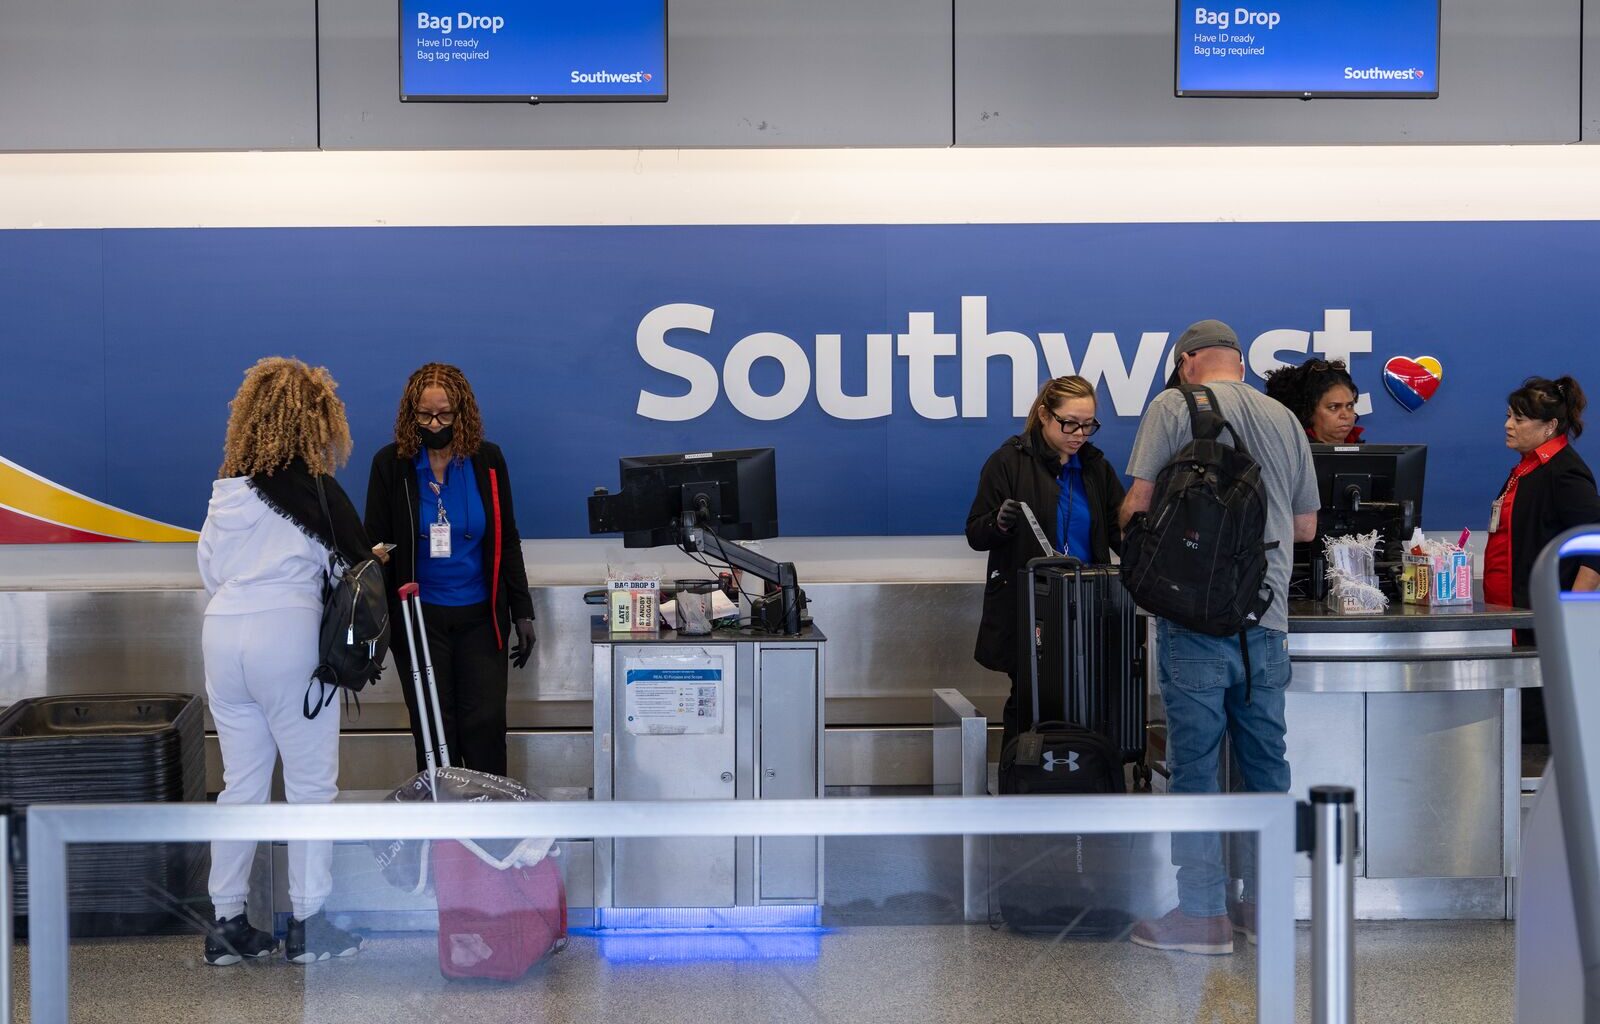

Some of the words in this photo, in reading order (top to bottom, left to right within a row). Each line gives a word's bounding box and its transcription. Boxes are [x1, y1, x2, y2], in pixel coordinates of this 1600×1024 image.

[417, 13, 452, 33] Bag
[457, 13, 504, 33] Drop
[1195, 8, 1229, 29] Bag
[1235, 8, 1280, 29] Drop
[417, 38, 440, 47] Have
[442, 38, 452, 47] ID
[454, 38, 479, 49] ready
[1194, 34, 1217, 42] Have
[1219, 34, 1228, 42] ID
[1230, 34, 1255, 45] ready
[417, 51, 434, 61] Bag
[436, 51, 450, 62] tag
[452, 50, 489, 62] required
[1194, 46, 1210, 56] Bag
[1212, 47, 1226, 57] tag
[1228, 46, 1265, 57] required
[571, 71, 642, 83] Southwest
[1344, 67, 1414, 80] Southwest
[636, 296, 1373, 422] Southwst
[1460, 567, 1468, 597] ATEWAY
